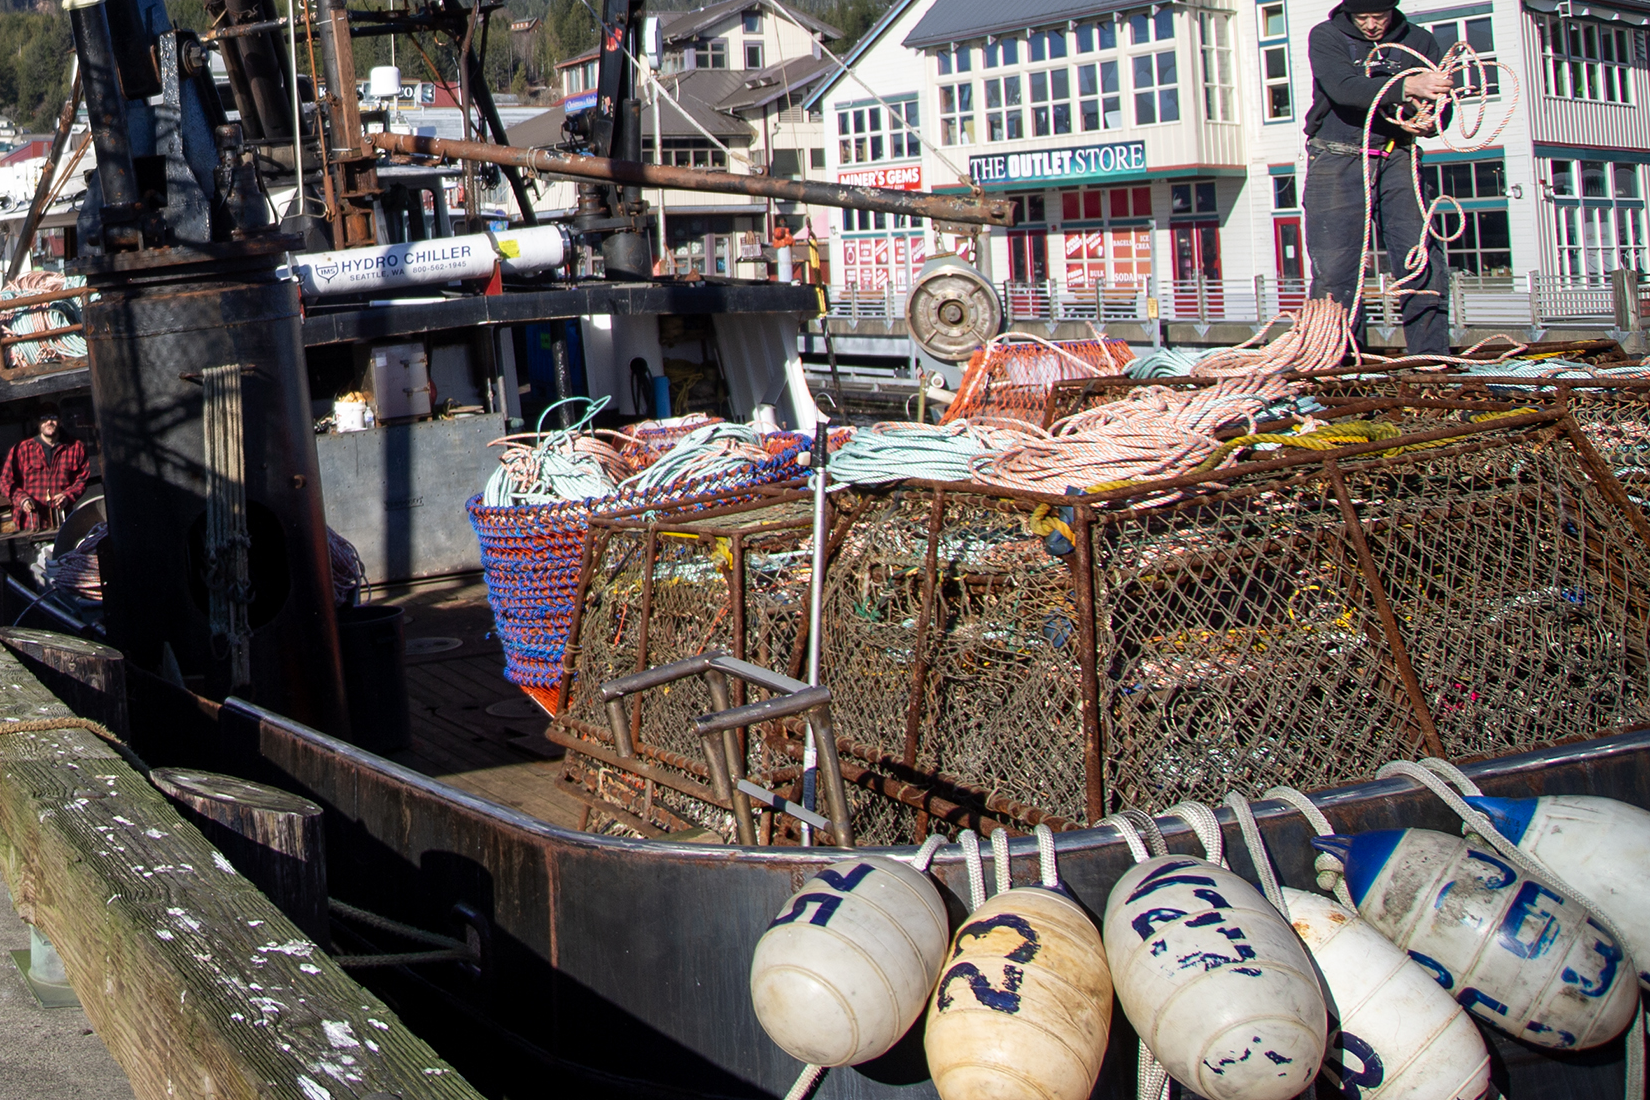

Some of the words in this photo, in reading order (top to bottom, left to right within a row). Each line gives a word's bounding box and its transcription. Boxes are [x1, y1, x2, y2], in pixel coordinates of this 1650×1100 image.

[970, 156, 1006, 181] THE
[1007, 150, 1073, 179] OUTLET
[1075, 143, 1145, 175] STORE
[840, 170, 885, 187] MINER'S
[886, 167, 920, 185] GEMS
[341, 254, 398, 274] HYDRO
[404, 245, 472, 265] CHILLER
[320, 268, 336, 276] IMS
[350, 271, 390, 282] SEATTLE,
[412, 260, 467, 274] 800-562-1945
[1114, 272, 1134, 282] SODA
